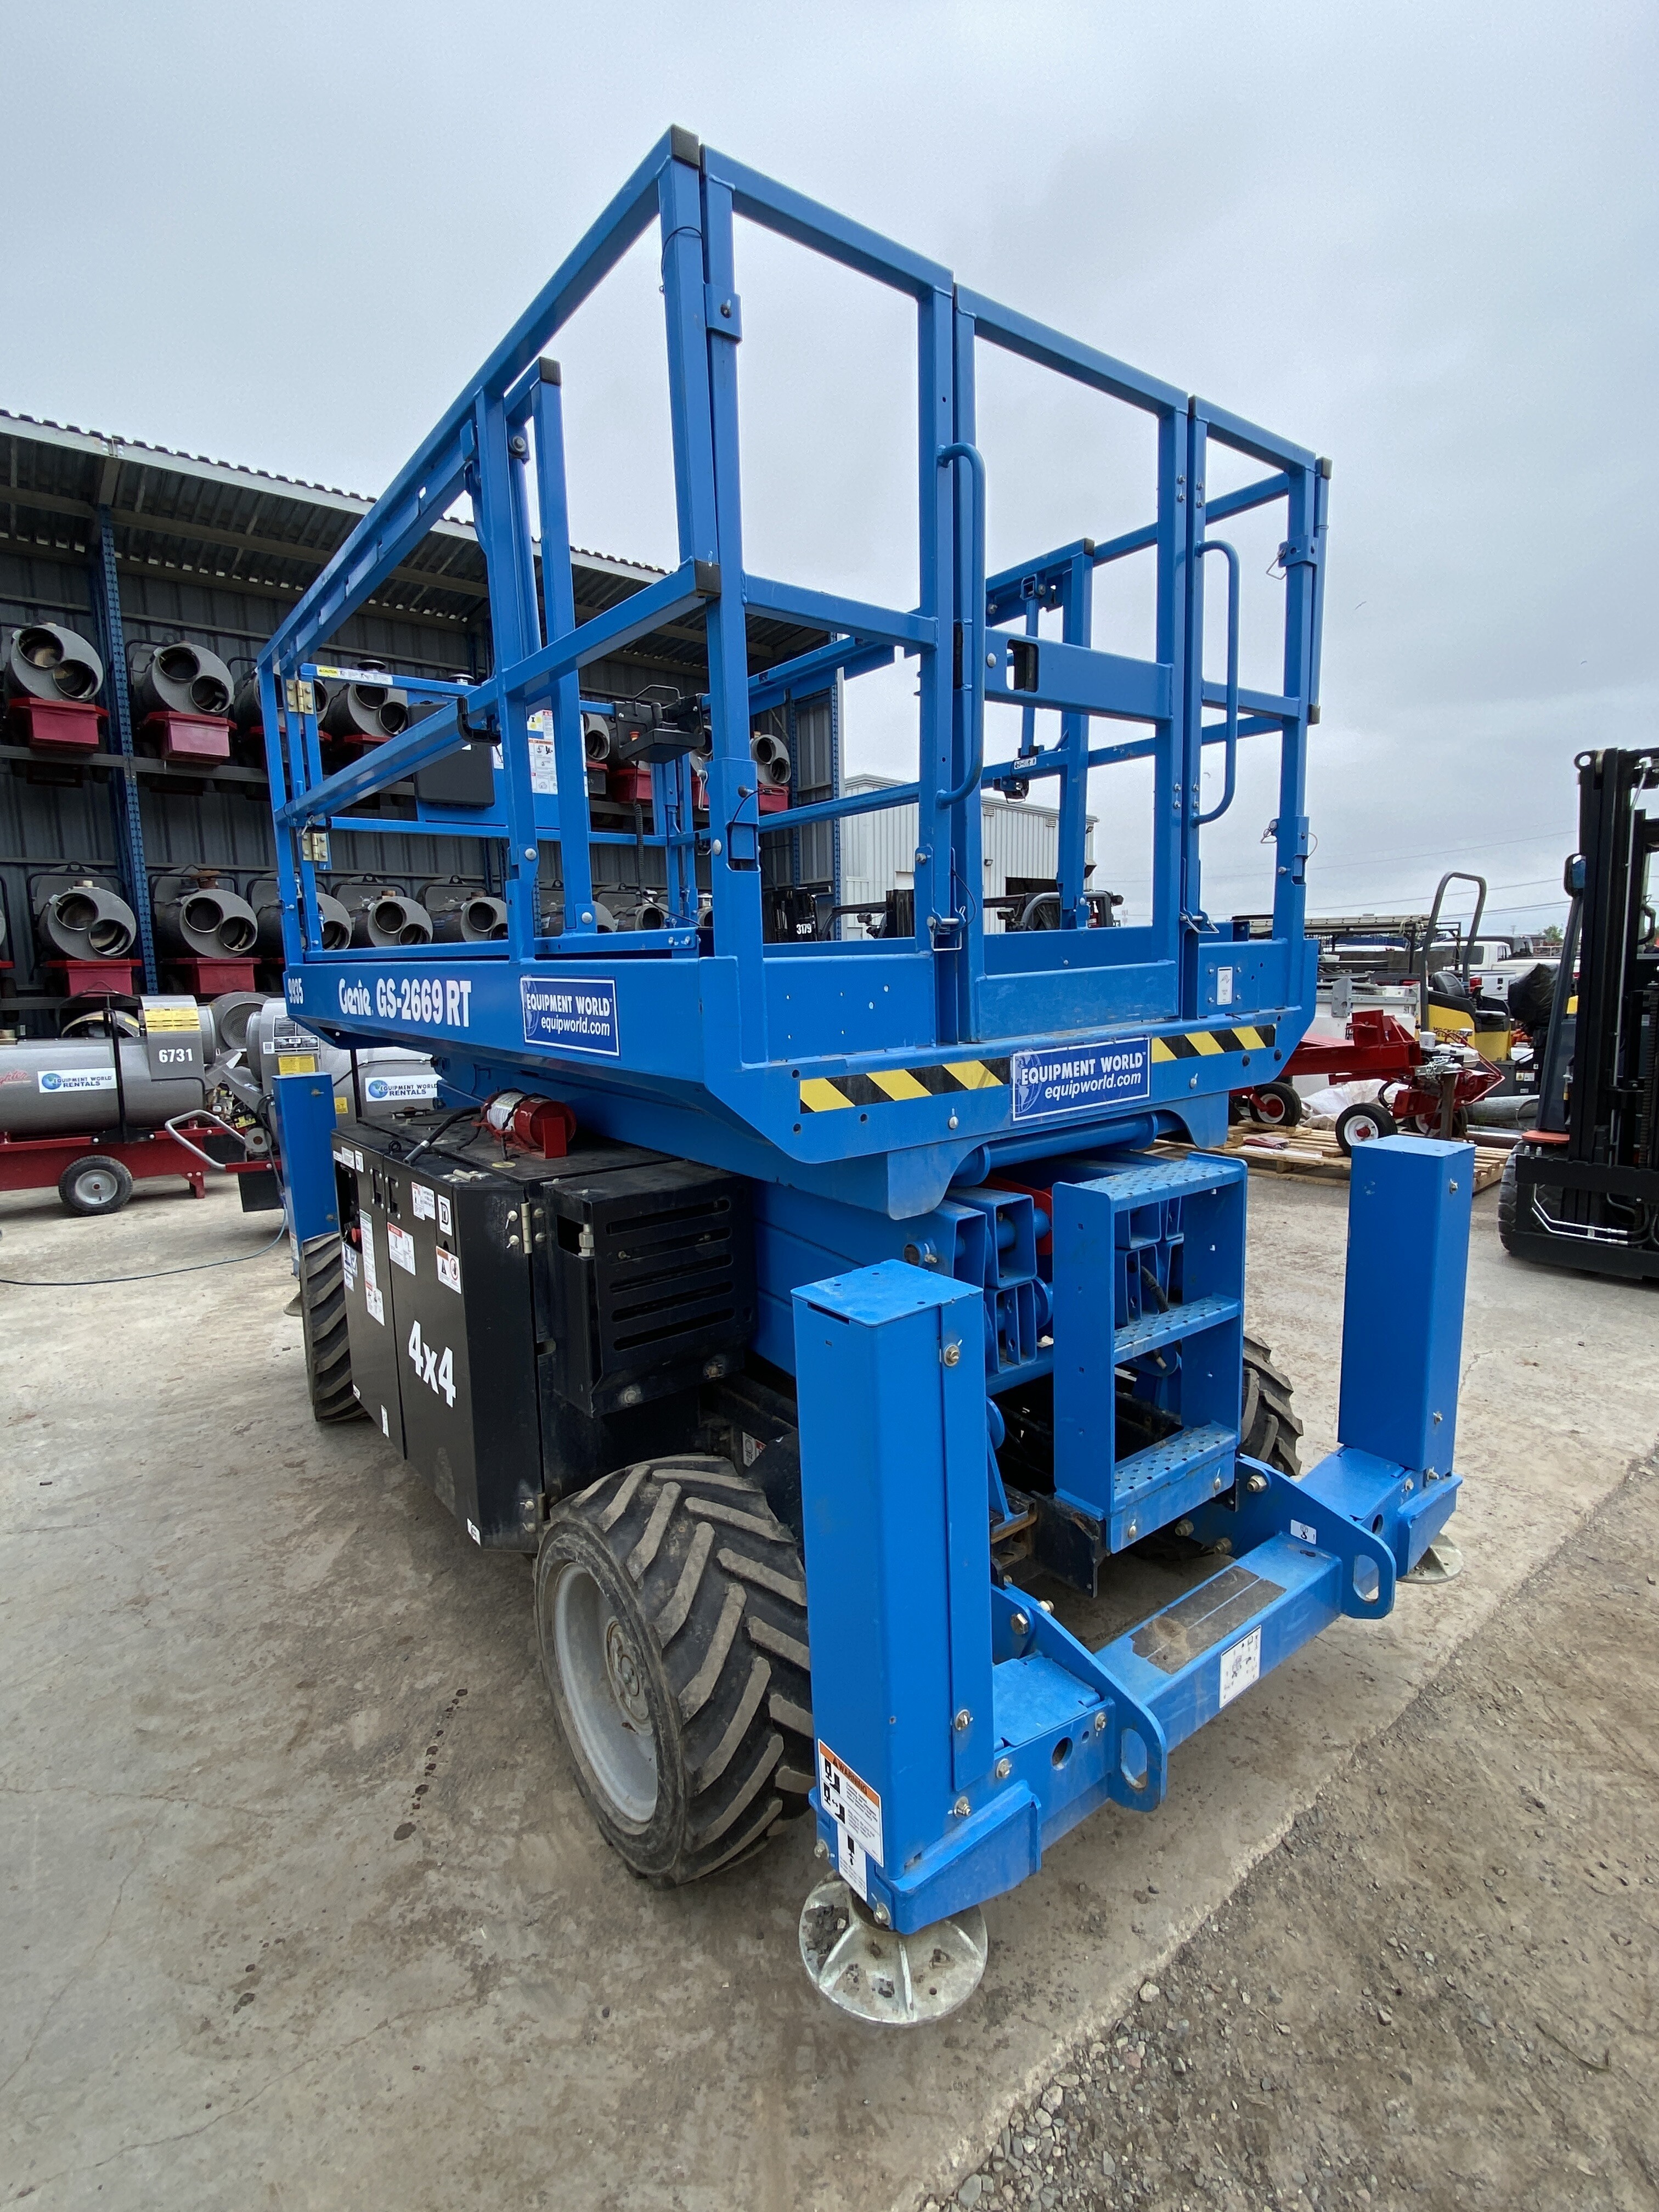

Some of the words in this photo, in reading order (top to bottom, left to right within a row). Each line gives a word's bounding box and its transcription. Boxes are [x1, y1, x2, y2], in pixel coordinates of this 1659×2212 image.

[796, 923, 812, 935] 3179
[338, 978, 372, 1016] Genie
[376, 978, 443, 1024] GS-2669
[446, 980, 472, 1028] RT
[527, 994, 572, 1013] EQUIPMENT
[575, 996, 611, 1017] WORLD
[541, 1014, 610, 1036] equipworld.com
[159, 1048, 193, 1063] 6731
[1021, 1058, 1096, 1086] EQUIPMENT
[1100, 1052, 1143, 1073] WORLD
[1045, 1072, 1142, 1101] equipworld.com
[408, 1320, 456, 1408] 4x4
[838, 1759, 868, 1795] WARNING
